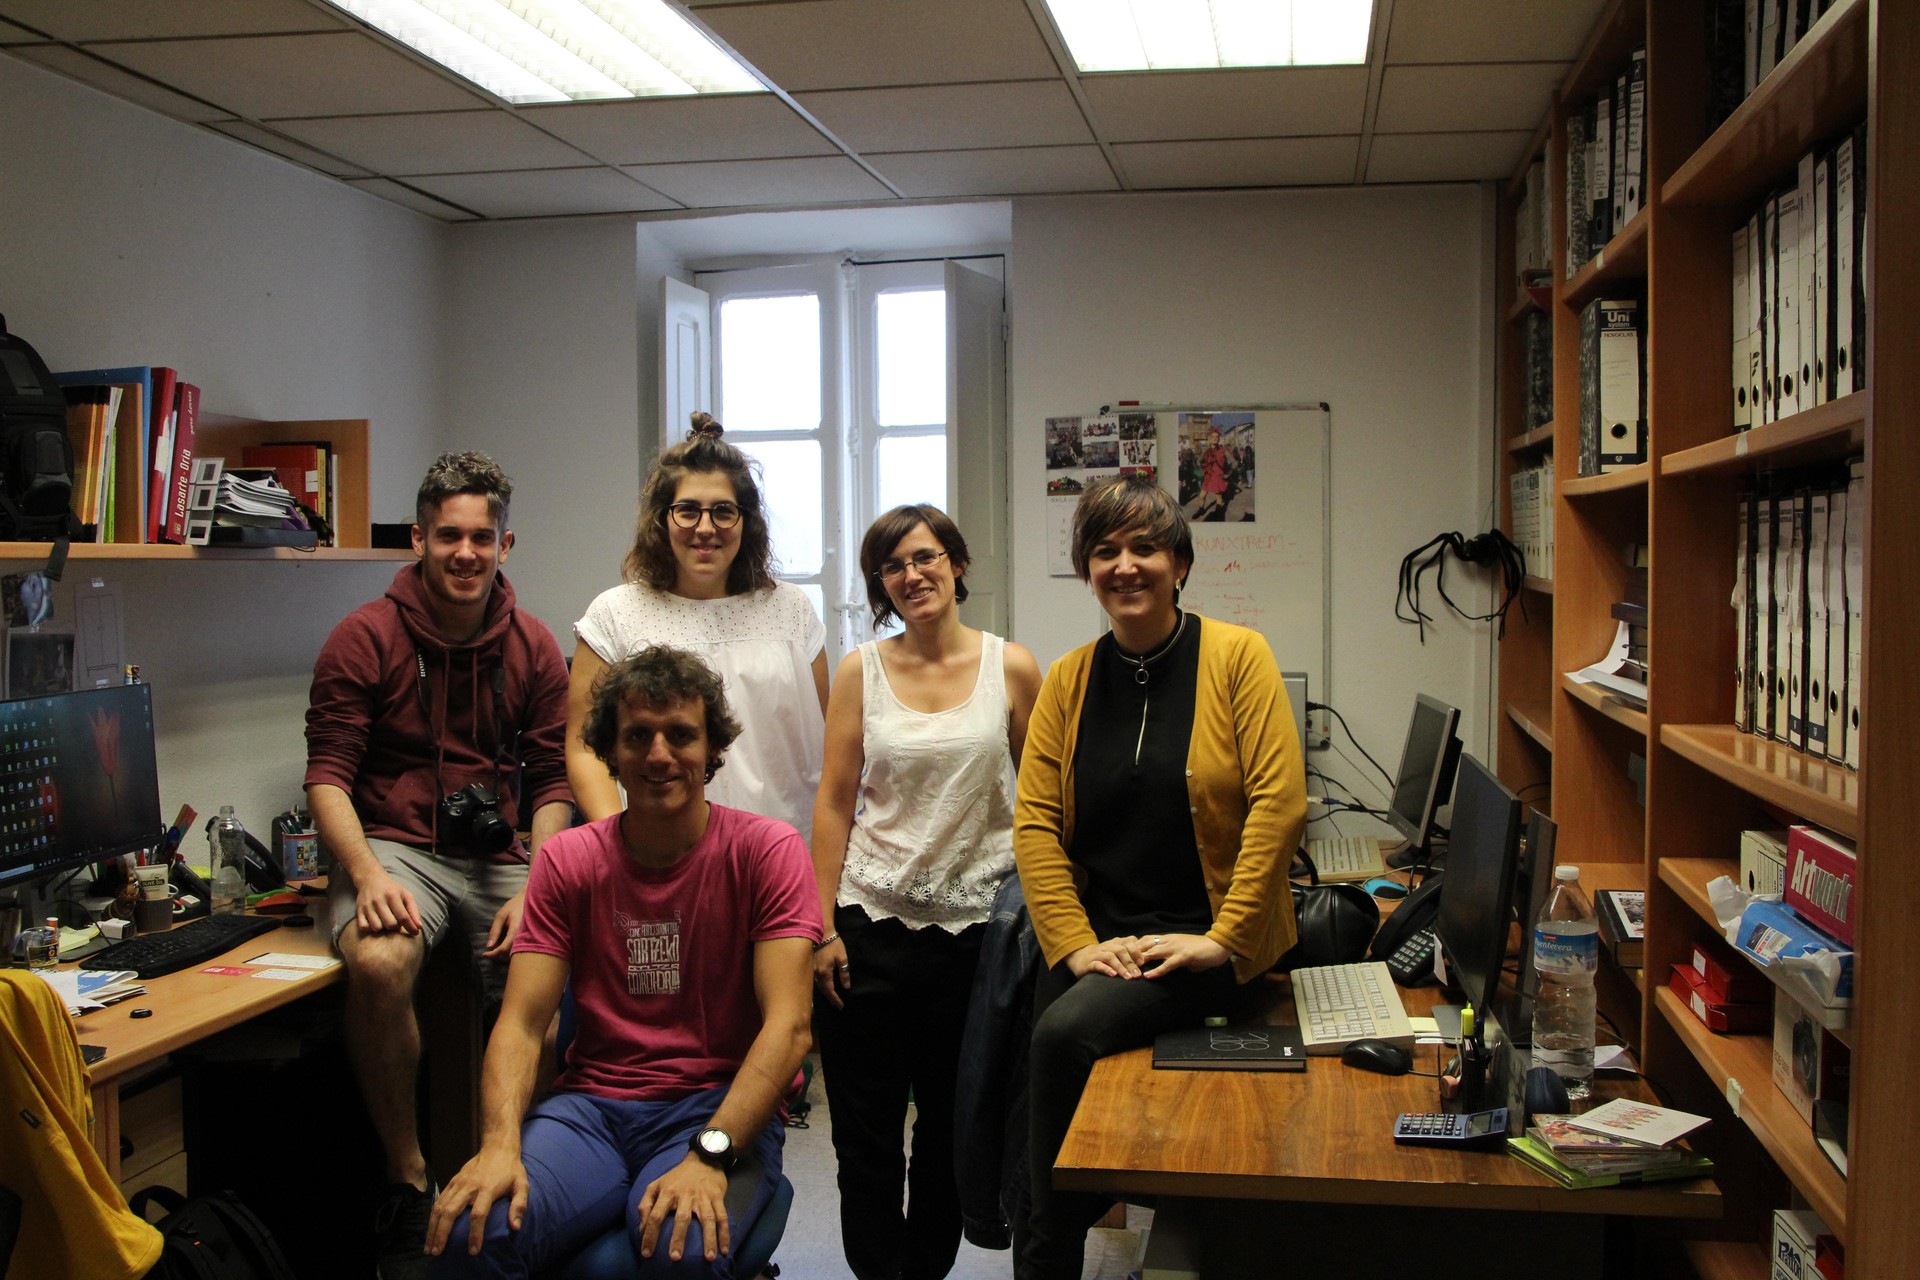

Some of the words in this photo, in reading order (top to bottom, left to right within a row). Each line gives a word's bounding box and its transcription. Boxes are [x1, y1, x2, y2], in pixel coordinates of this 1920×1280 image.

[1607, 311, 1630, 323] Uni
[179, 448, 191, 471] Oria
[174, 477, 188, 518] Lasarte
[1791, 848, 1852, 924] Artwork
